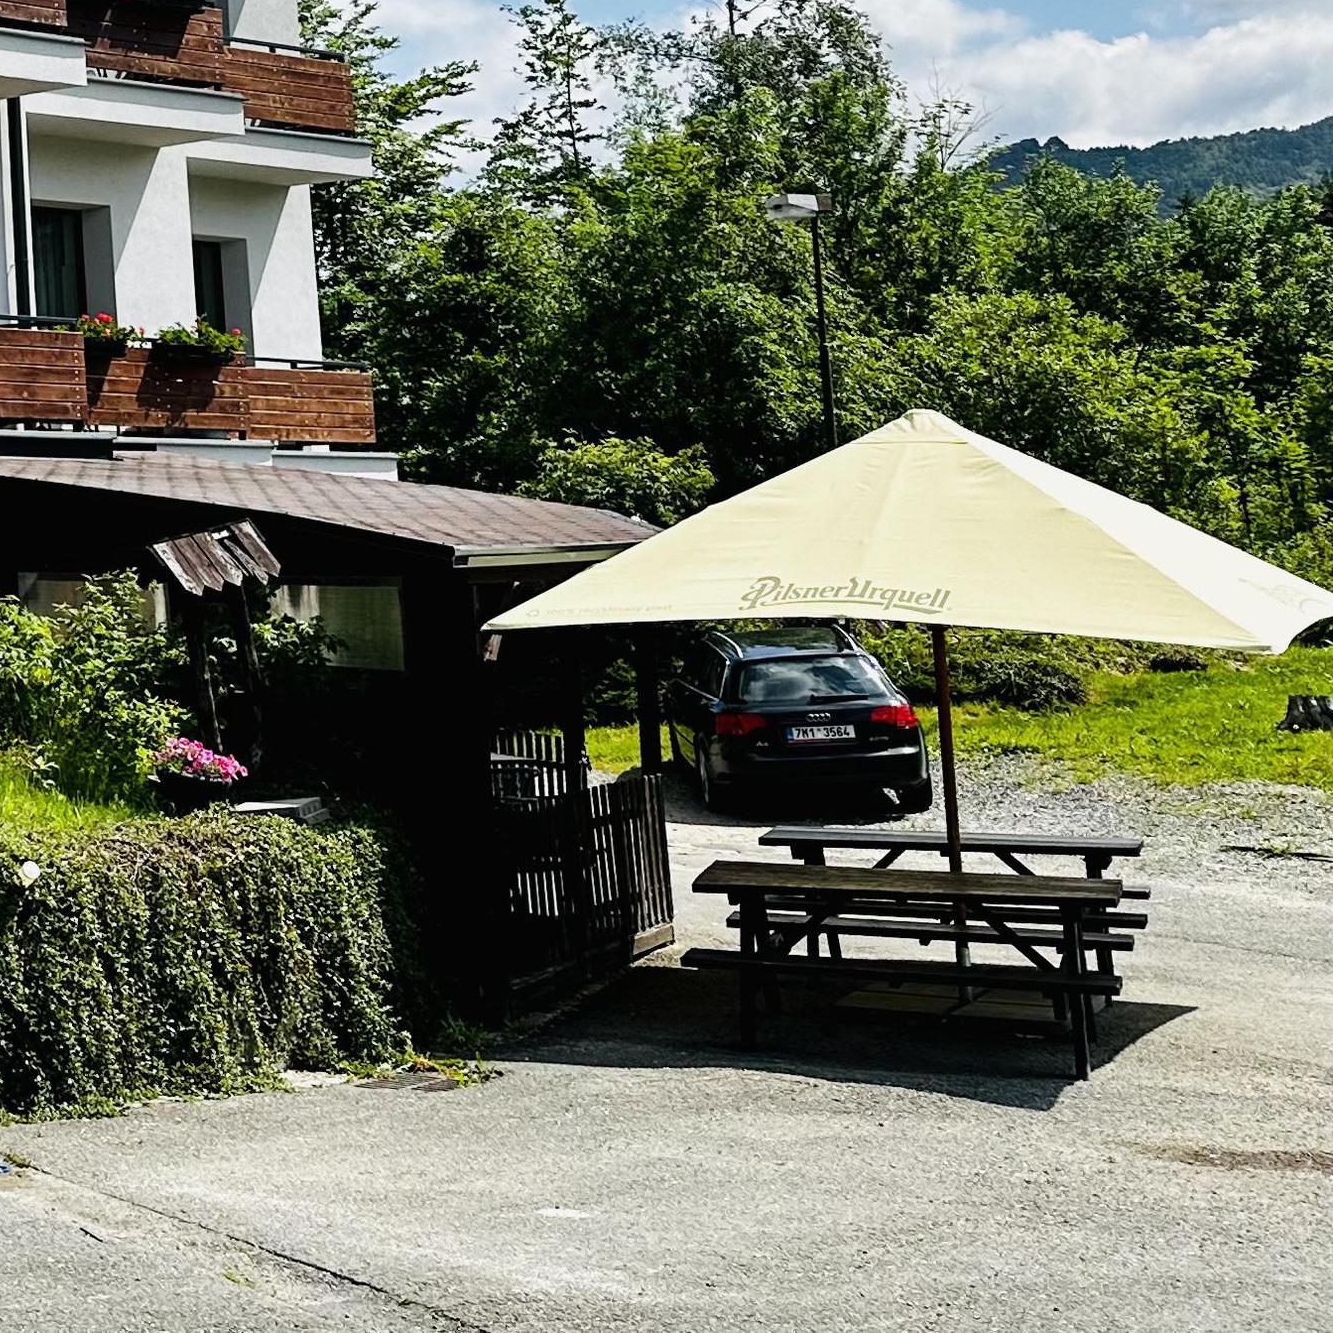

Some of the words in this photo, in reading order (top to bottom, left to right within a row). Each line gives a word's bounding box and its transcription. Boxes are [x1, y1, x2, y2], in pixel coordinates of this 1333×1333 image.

[738, 576, 849, 611] Pilsner
[846, 577, 951, 614] Urquell
[823, 726, 850, 737] 3564
